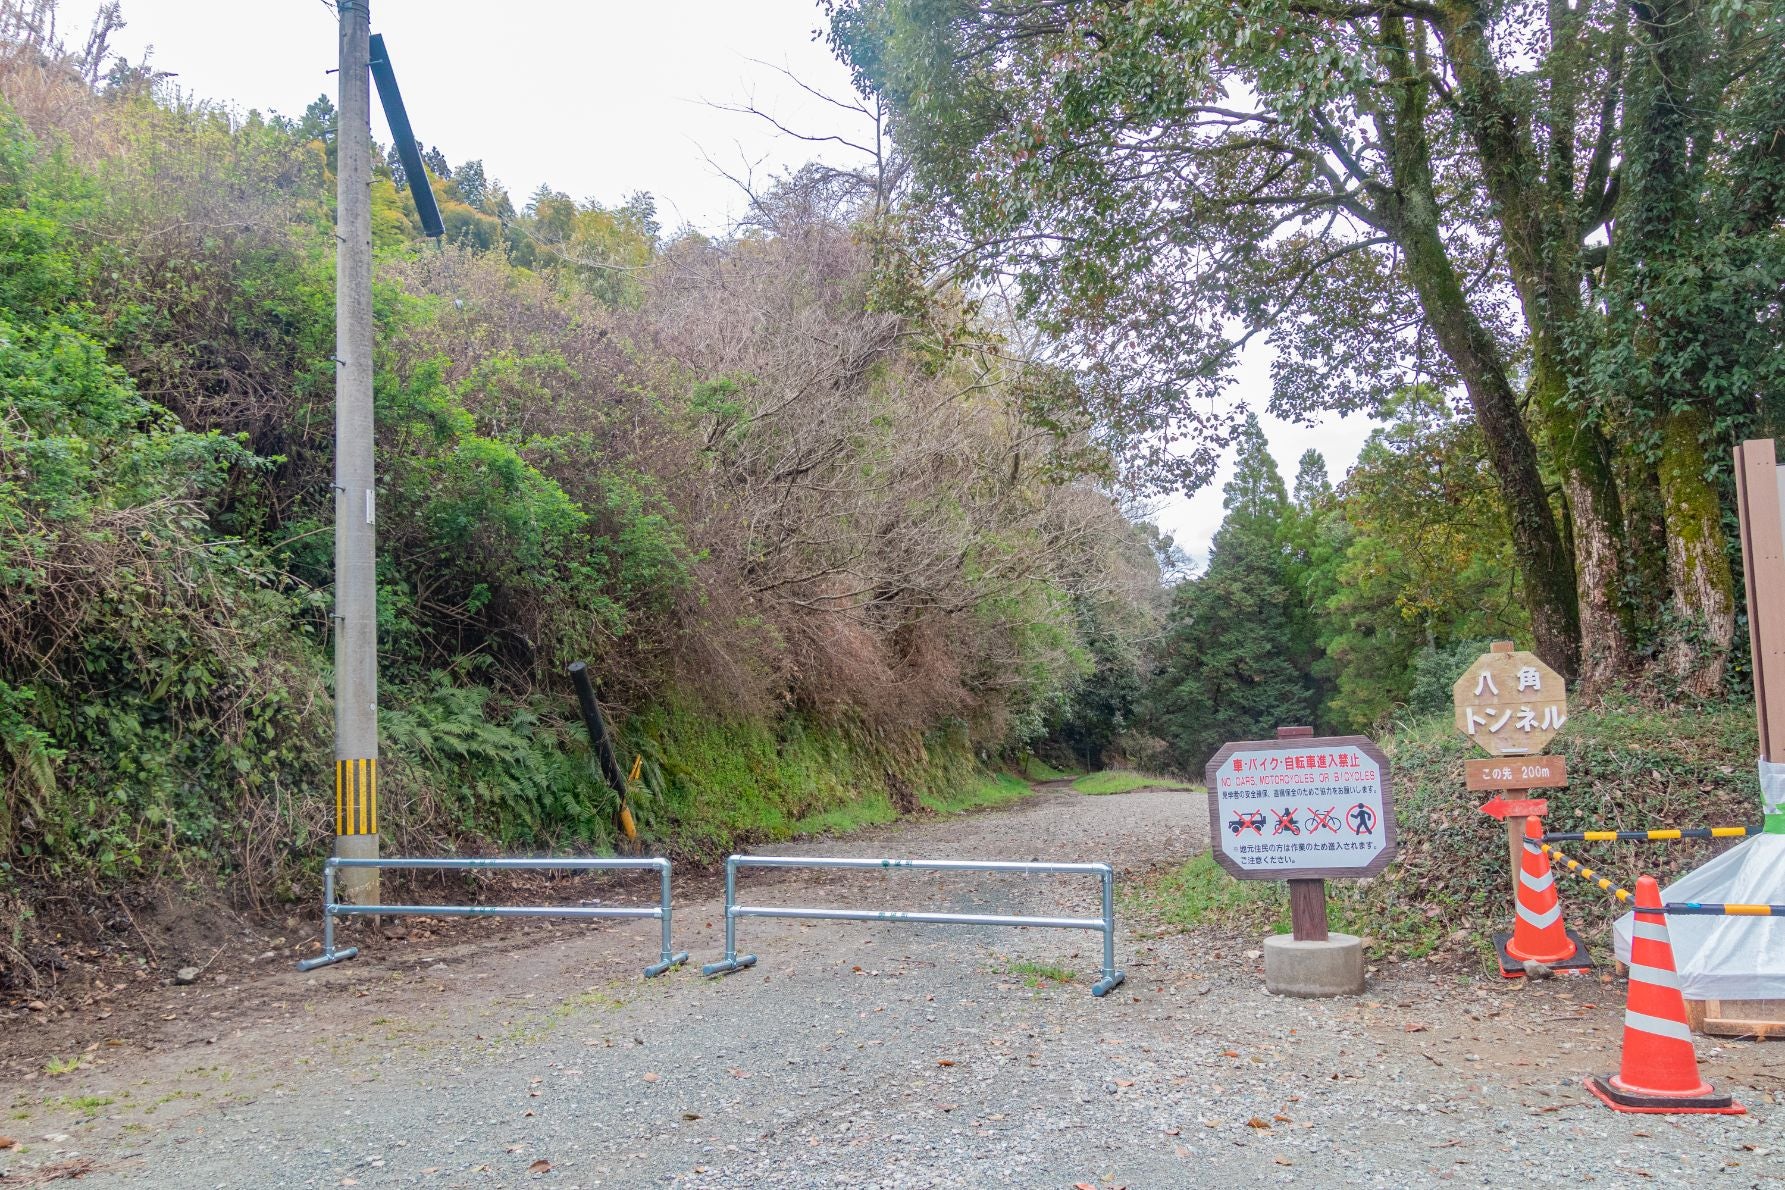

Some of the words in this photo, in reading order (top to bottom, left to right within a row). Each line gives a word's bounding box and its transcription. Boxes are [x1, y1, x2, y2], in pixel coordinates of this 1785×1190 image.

[1474, 666, 1541, 696] 八角
[1466, 705, 1567, 735] トンネル
[1221, 777, 1231, 787] NO
[1259, 773, 1315, 785] MOTORCYCLES
[1319, 772, 1330, 783] OR
[1333, 770, 1376, 782] BICYCLES
[1482, 766, 1513, 780] この先
[1521, 765, 1550, 779] 200m
[1241, 855, 1296, 865] ご注意ください。
